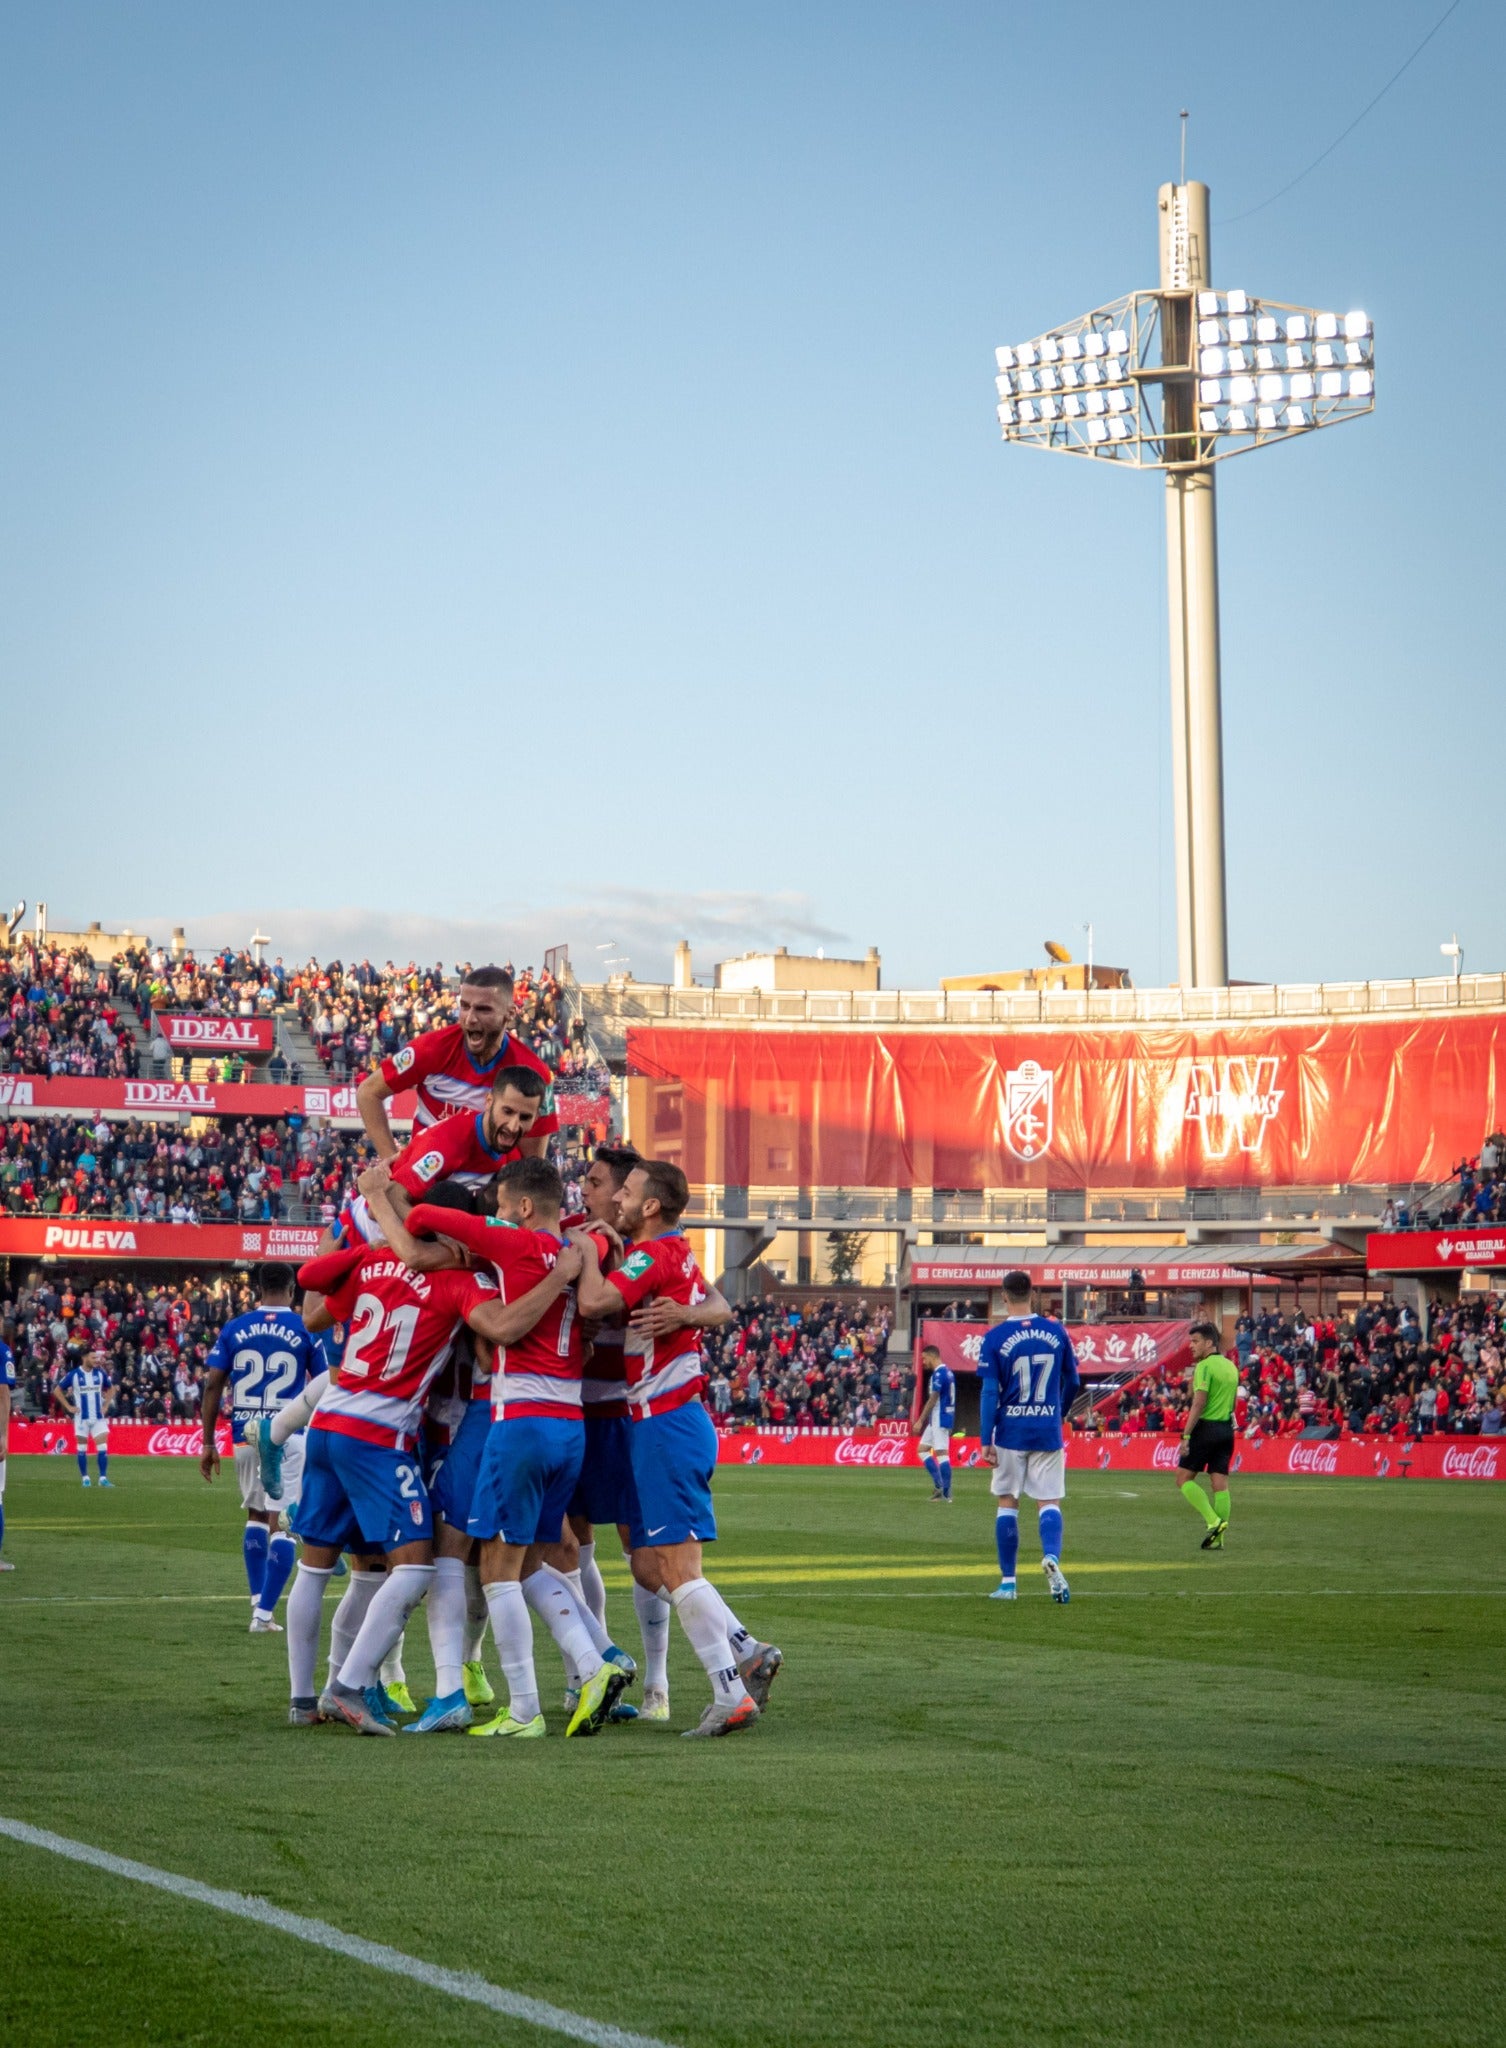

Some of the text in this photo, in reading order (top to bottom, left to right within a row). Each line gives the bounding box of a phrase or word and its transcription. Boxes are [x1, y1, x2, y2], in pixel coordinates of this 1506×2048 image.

[170, 1019, 259, 1041] IDEAL
[124, 1082, 215, 1104] IDEAL
[45, 1226, 137, 1249] PULEVA
[269, 1229, 318, 1242] CERVEZAS
[1455, 1239, 1506, 1252] CAJA RURAL
[360, 1261, 432, 1300] HERRERA
[932, 1268, 973, 1279] CERVEZAS
[975, 1268, 1022, 1279] ALHAM
[1058, 1268, 1098, 1279] CERVEZAS
[1101, 1268, 1147, 1279] ALHAMA
[1181, 1268, 1266, 1279] CERVEZAS ALHAM
[235, 1323, 303, 1348] M.WAKASO
[340, 1292, 420, 1382] 21
[1000, 1329, 1061, 1357] ADRIÁN MARÍN
[233, 1349, 298, 1409] 22
[1012, 1353, 1055, 1403] 17
[147, 1427, 229, 1454] Coca-Ca
[835, 1437, 907, 1464] Coca-Cola
[1288, 1442, 1339, 1472] Coca-Cola
[1442, 1445, 1500, 1477] Coca-Cola
